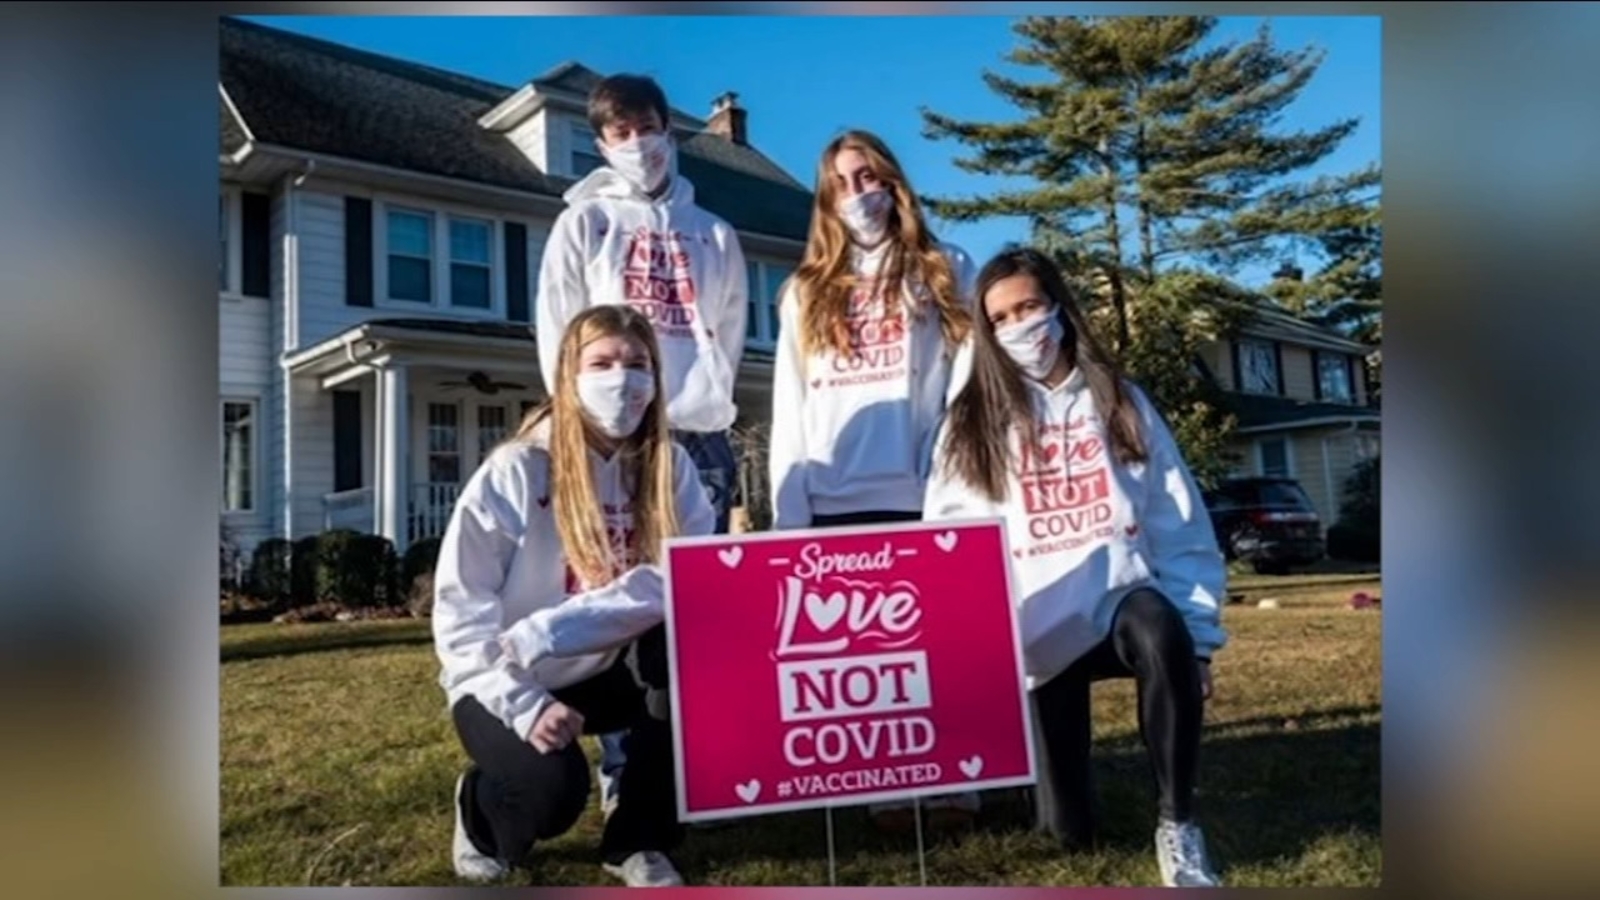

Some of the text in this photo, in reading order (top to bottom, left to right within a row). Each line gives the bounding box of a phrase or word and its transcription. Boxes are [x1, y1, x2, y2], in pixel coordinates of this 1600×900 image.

[1028, 477, 1102, 512] NOT
[1028, 503, 1112, 540] COVID
[795, 542, 895, 581] Spread
[791, 661, 916, 714] NOT
[783, 716, 936, 767] COVID
[777, 763, 941, 797] #VACCINATED
